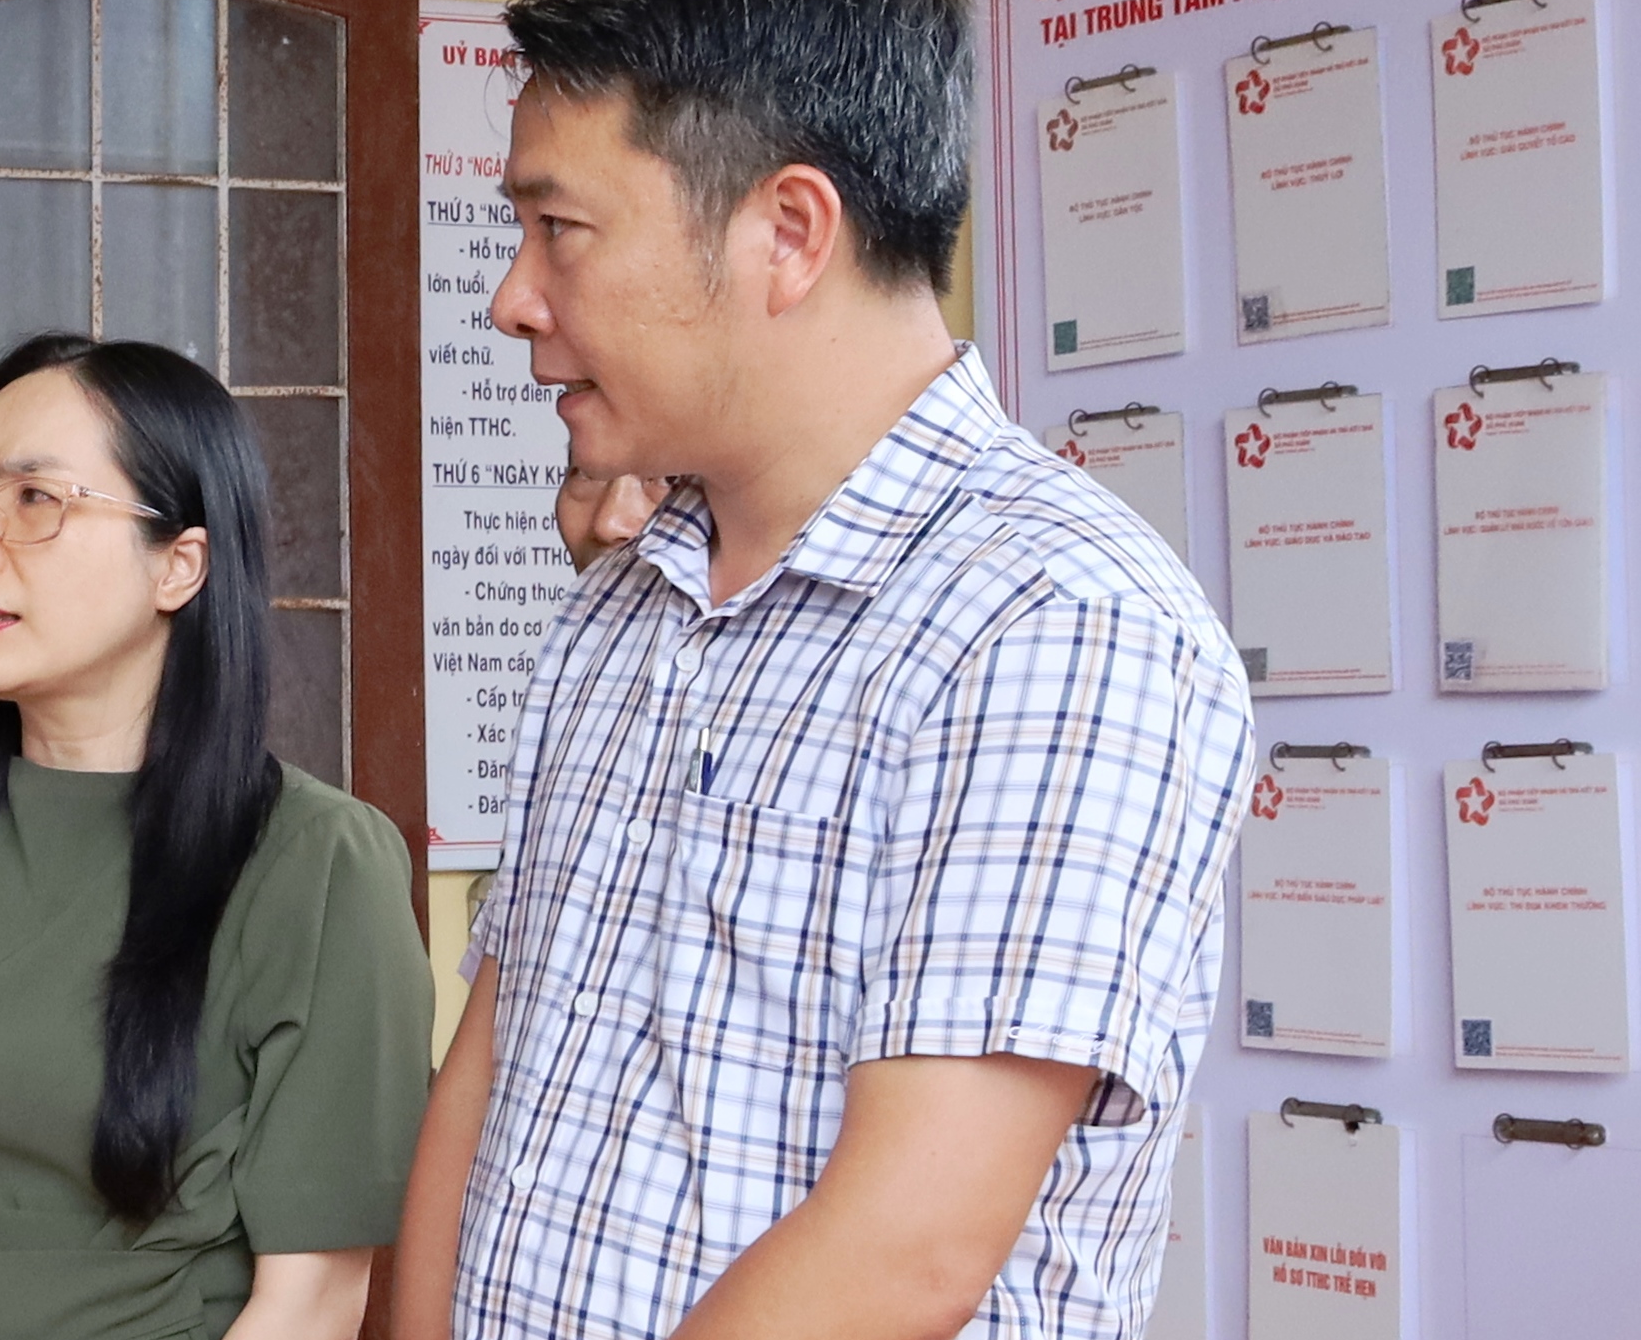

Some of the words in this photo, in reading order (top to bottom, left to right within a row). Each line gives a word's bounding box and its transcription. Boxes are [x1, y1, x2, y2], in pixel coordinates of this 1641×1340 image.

[1040, 11, 1077, 48] TẠI
[443, 40, 467, 66] UỶ
[425, 149, 455, 176] THỨ
[455, 157, 463, 177] 3
[427, 196, 461, 223] THỨ
[465, 203, 475, 224] 3
[470, 236, 491, 260] Hỗ
[427, 273, 451, 294] lớn
[456, 269, 490, 295] tuổi.
[429, 343, 457, 365] viết
[462, 346, 495, 366] chữ.
[472, 378, 492, 401] Hỗ
[496, 383, 517, 405] trợ
[430, 416, 463, 440] hiện
[469, 416, 516, 438] TTHC.
[433, 458, 467, 484] THỨ
[471, 464, 480, 485] 6
[464, 510, 501, 534] Thực
[505, 511, 537, 535] hiện
[431, 545, 469, 571] ngày
[475, 543, 499, 566] đối
[504, 545, 527, 566] với
[475, 581, 527, 606] Chứng
[433, 616, 460, 637] văn
[465, 614, 494, 637] bản
[499, 617, 519, 637] do
[523, 619, 542, 637] cơ
[433, 652, 463, 677] Việt
[468, 652, 502, 672] Nam
[507, 649, 536, 677] cấp
[476, 684, 507, 711] Cấp
[477, 722, 506, 744] Xác
[1310, 1243, 1328, 1263] XIN
